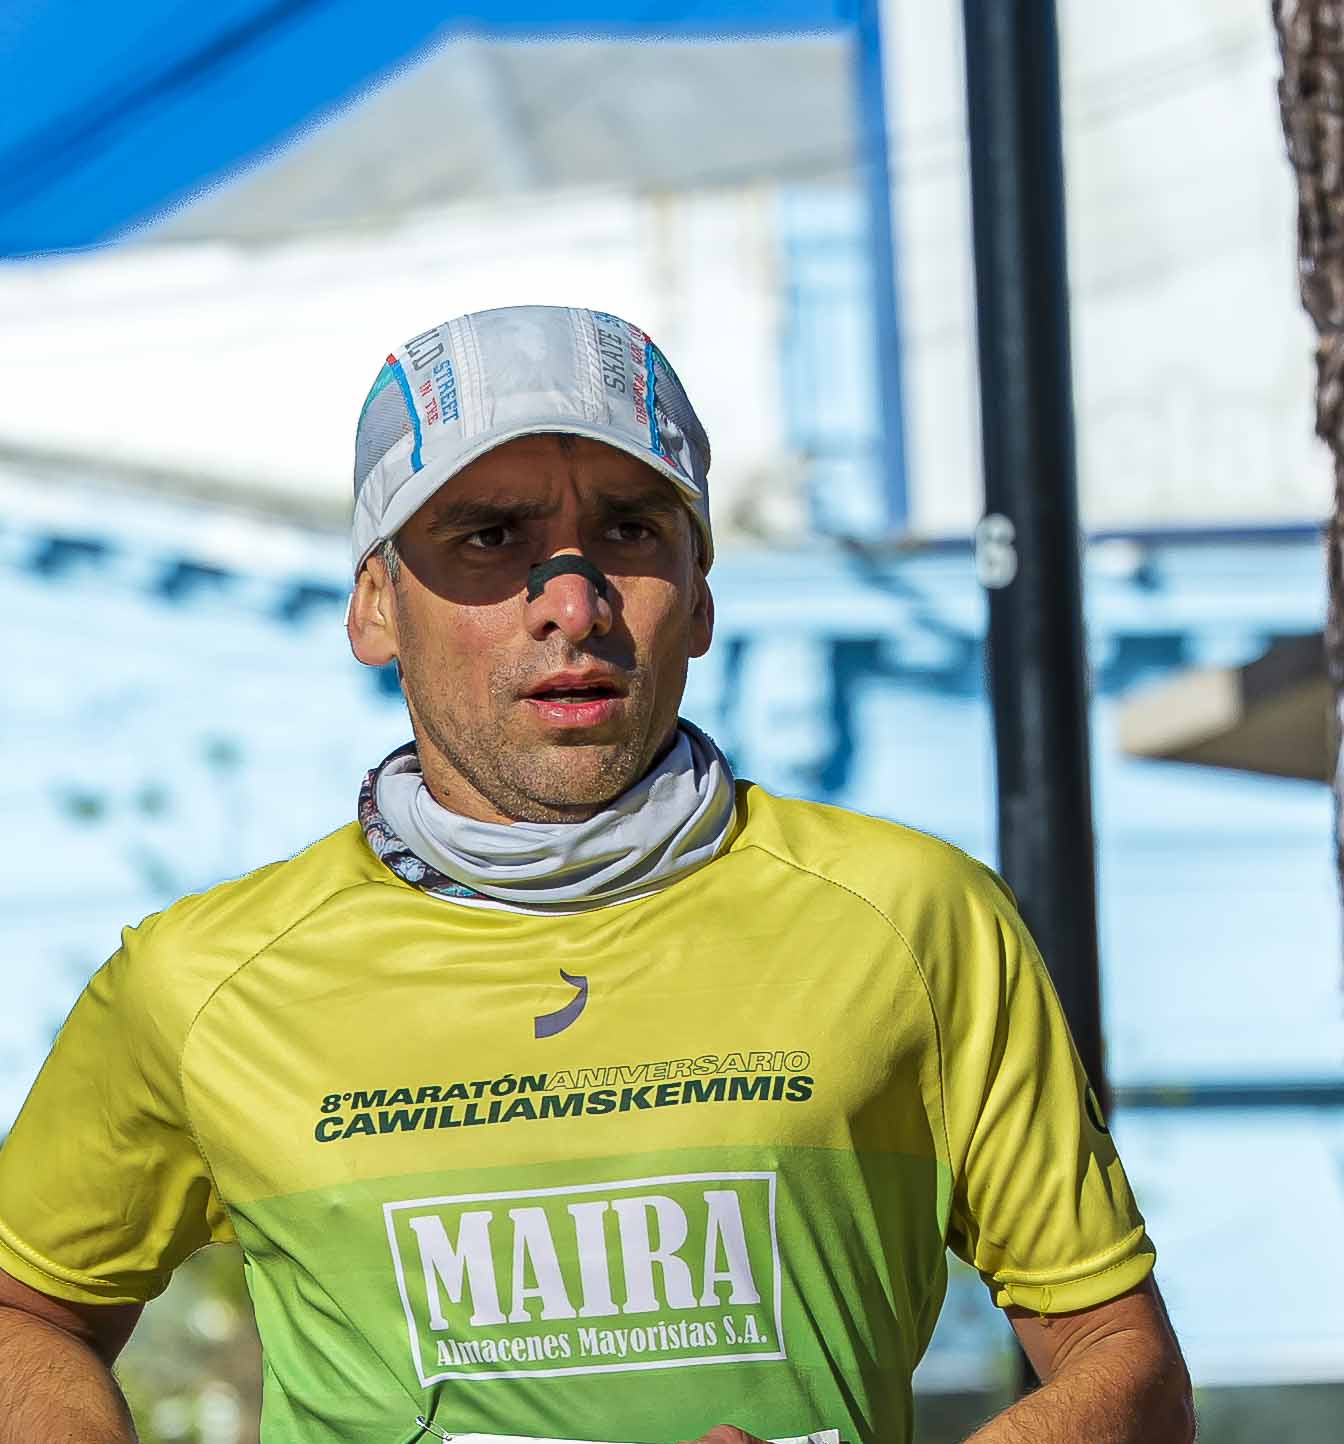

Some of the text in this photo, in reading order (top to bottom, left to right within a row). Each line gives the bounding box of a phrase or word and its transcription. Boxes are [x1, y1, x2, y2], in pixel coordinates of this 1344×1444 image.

[433, 359, 459, 424] STREET
[597, 328, 625, 394] SKATE
[544, 1051, 811, 1091] ANIVERSARIO
[314, 1075, 815, 1143] CAWILLIAMSKEMMIS
[409, 1190, 760, 1331] MAIRA
[437, 1315, 768, 1367] Almacenes Mayoristas S.A.
